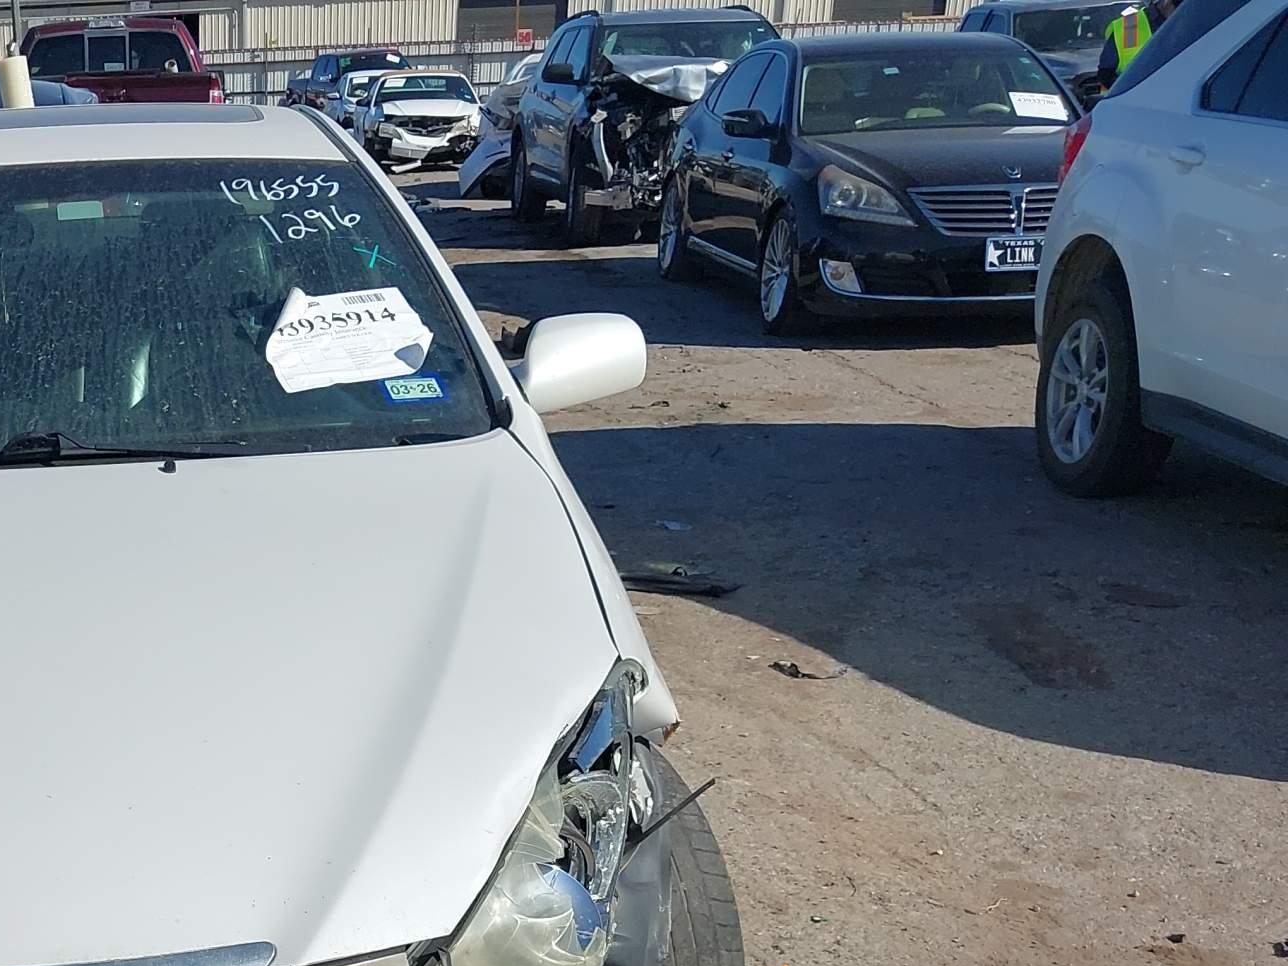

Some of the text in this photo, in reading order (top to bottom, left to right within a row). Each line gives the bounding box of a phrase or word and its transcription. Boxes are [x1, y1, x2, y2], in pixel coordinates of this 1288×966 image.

[220, 174, 340, 205] 196555
[259, 205, 361, 243] 1296
[1007, 247, 1035, 263] LINK
